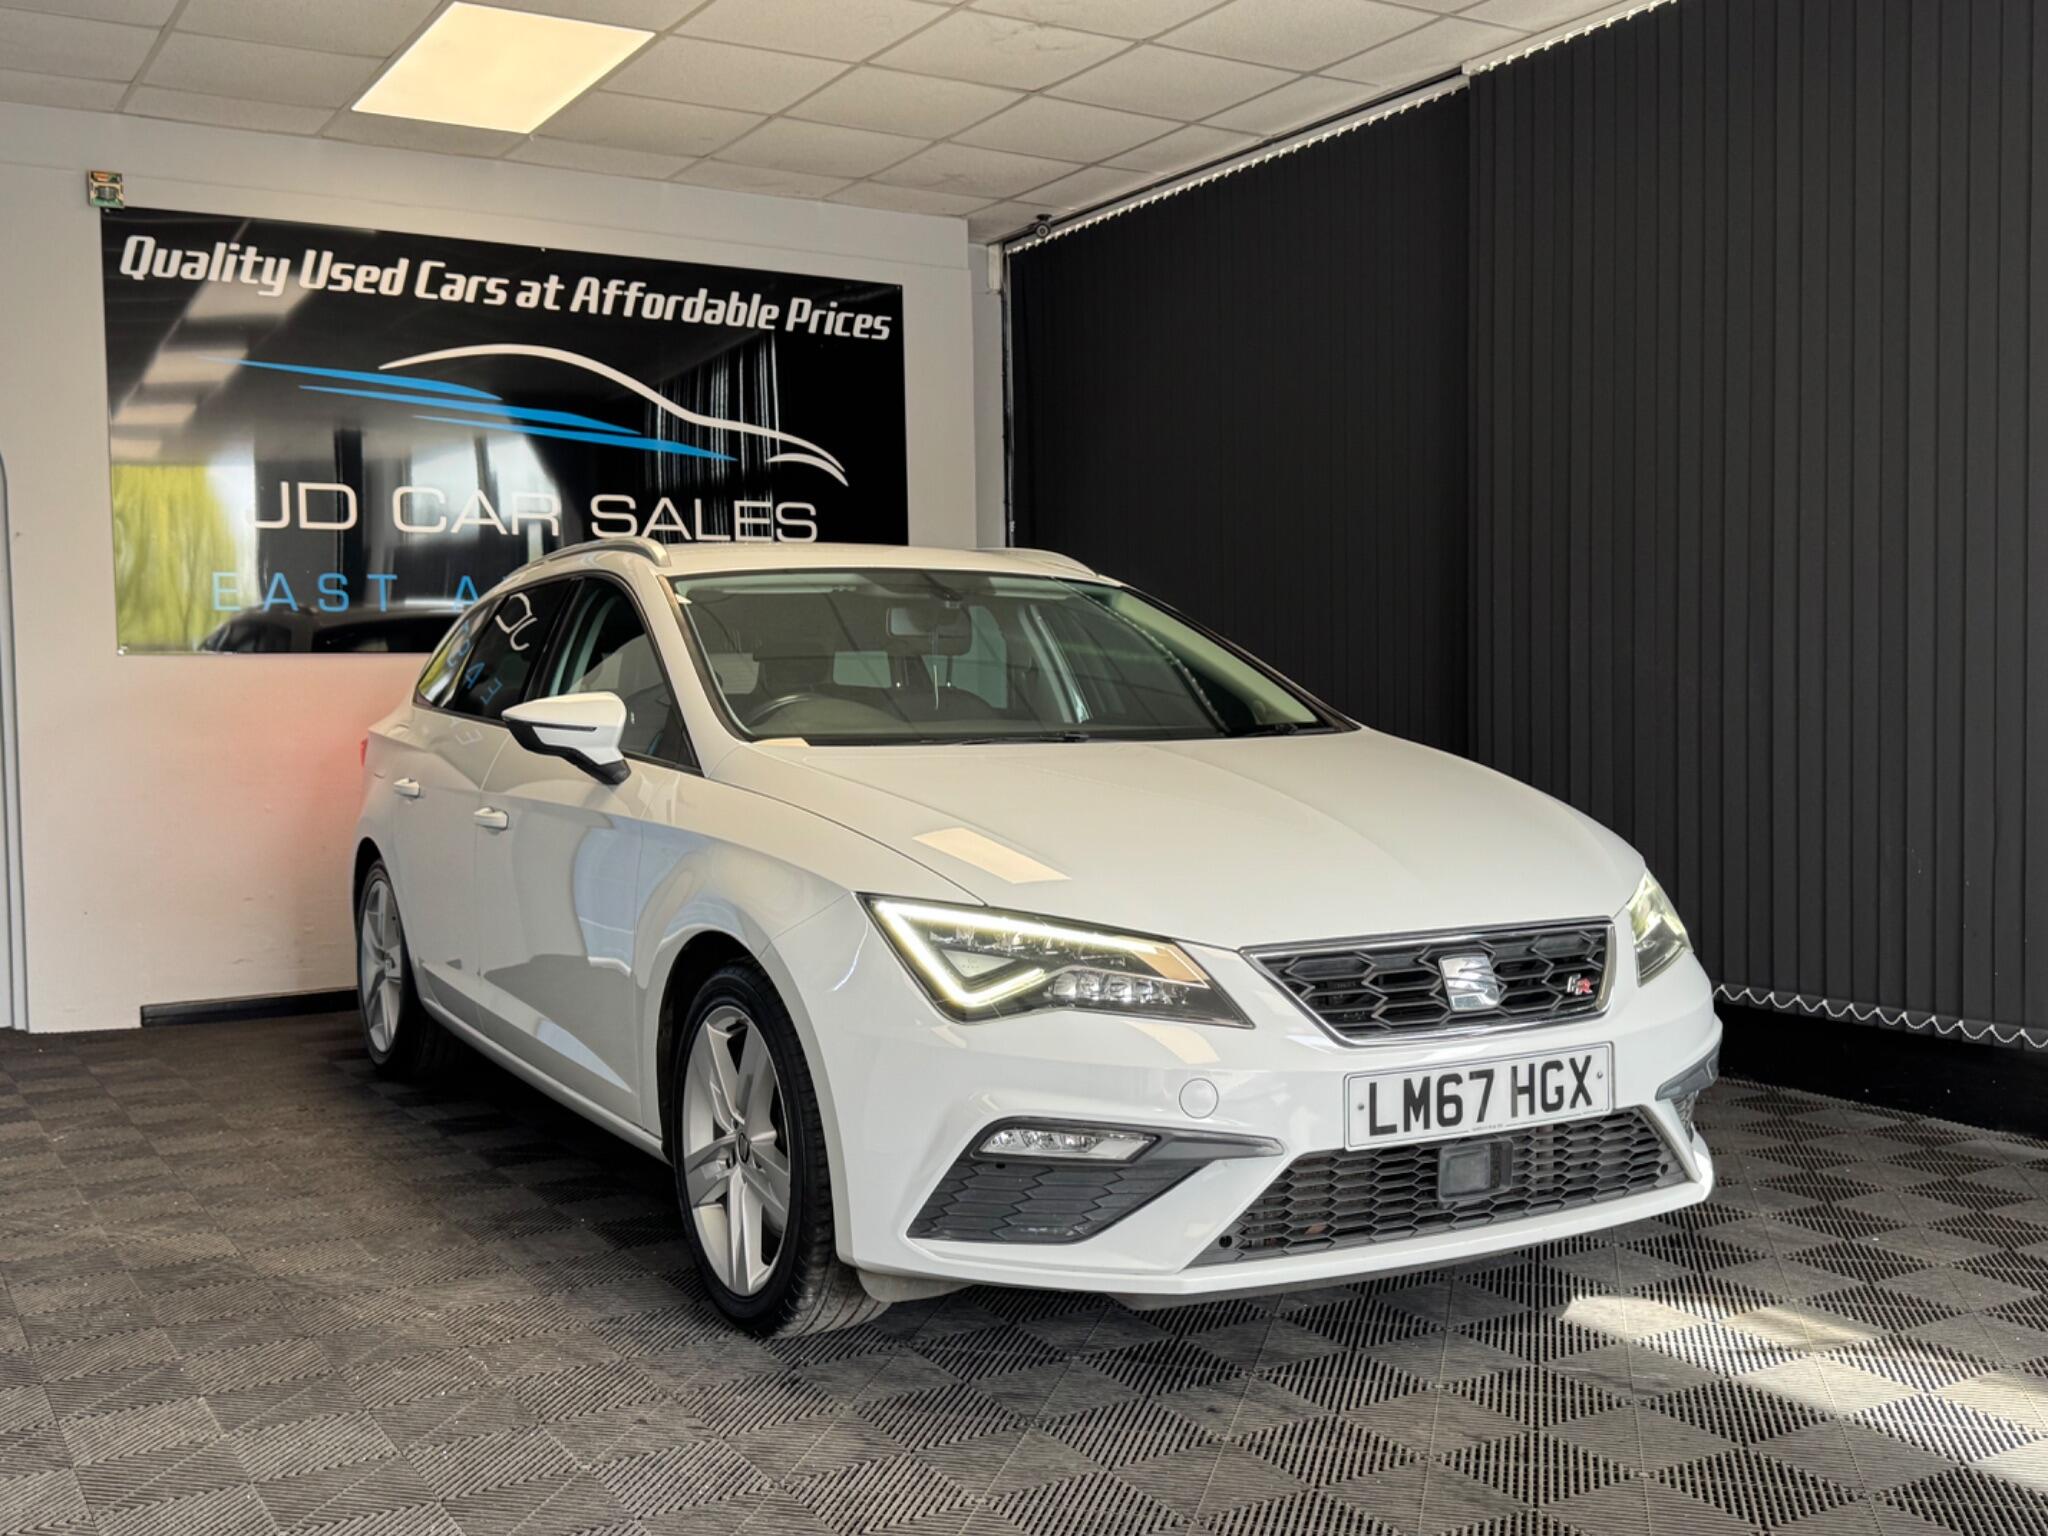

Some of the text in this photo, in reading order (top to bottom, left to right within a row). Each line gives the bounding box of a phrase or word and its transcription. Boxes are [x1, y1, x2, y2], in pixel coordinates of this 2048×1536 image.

[119, 235, 893, 341] Quality Used Cars at Affordable Prices
[246, 481, 819, 544] JD CAR SALES
[210, 571, 399, 612] EAST
[1368, 1055, 1594, 1137] LM67 HGX
